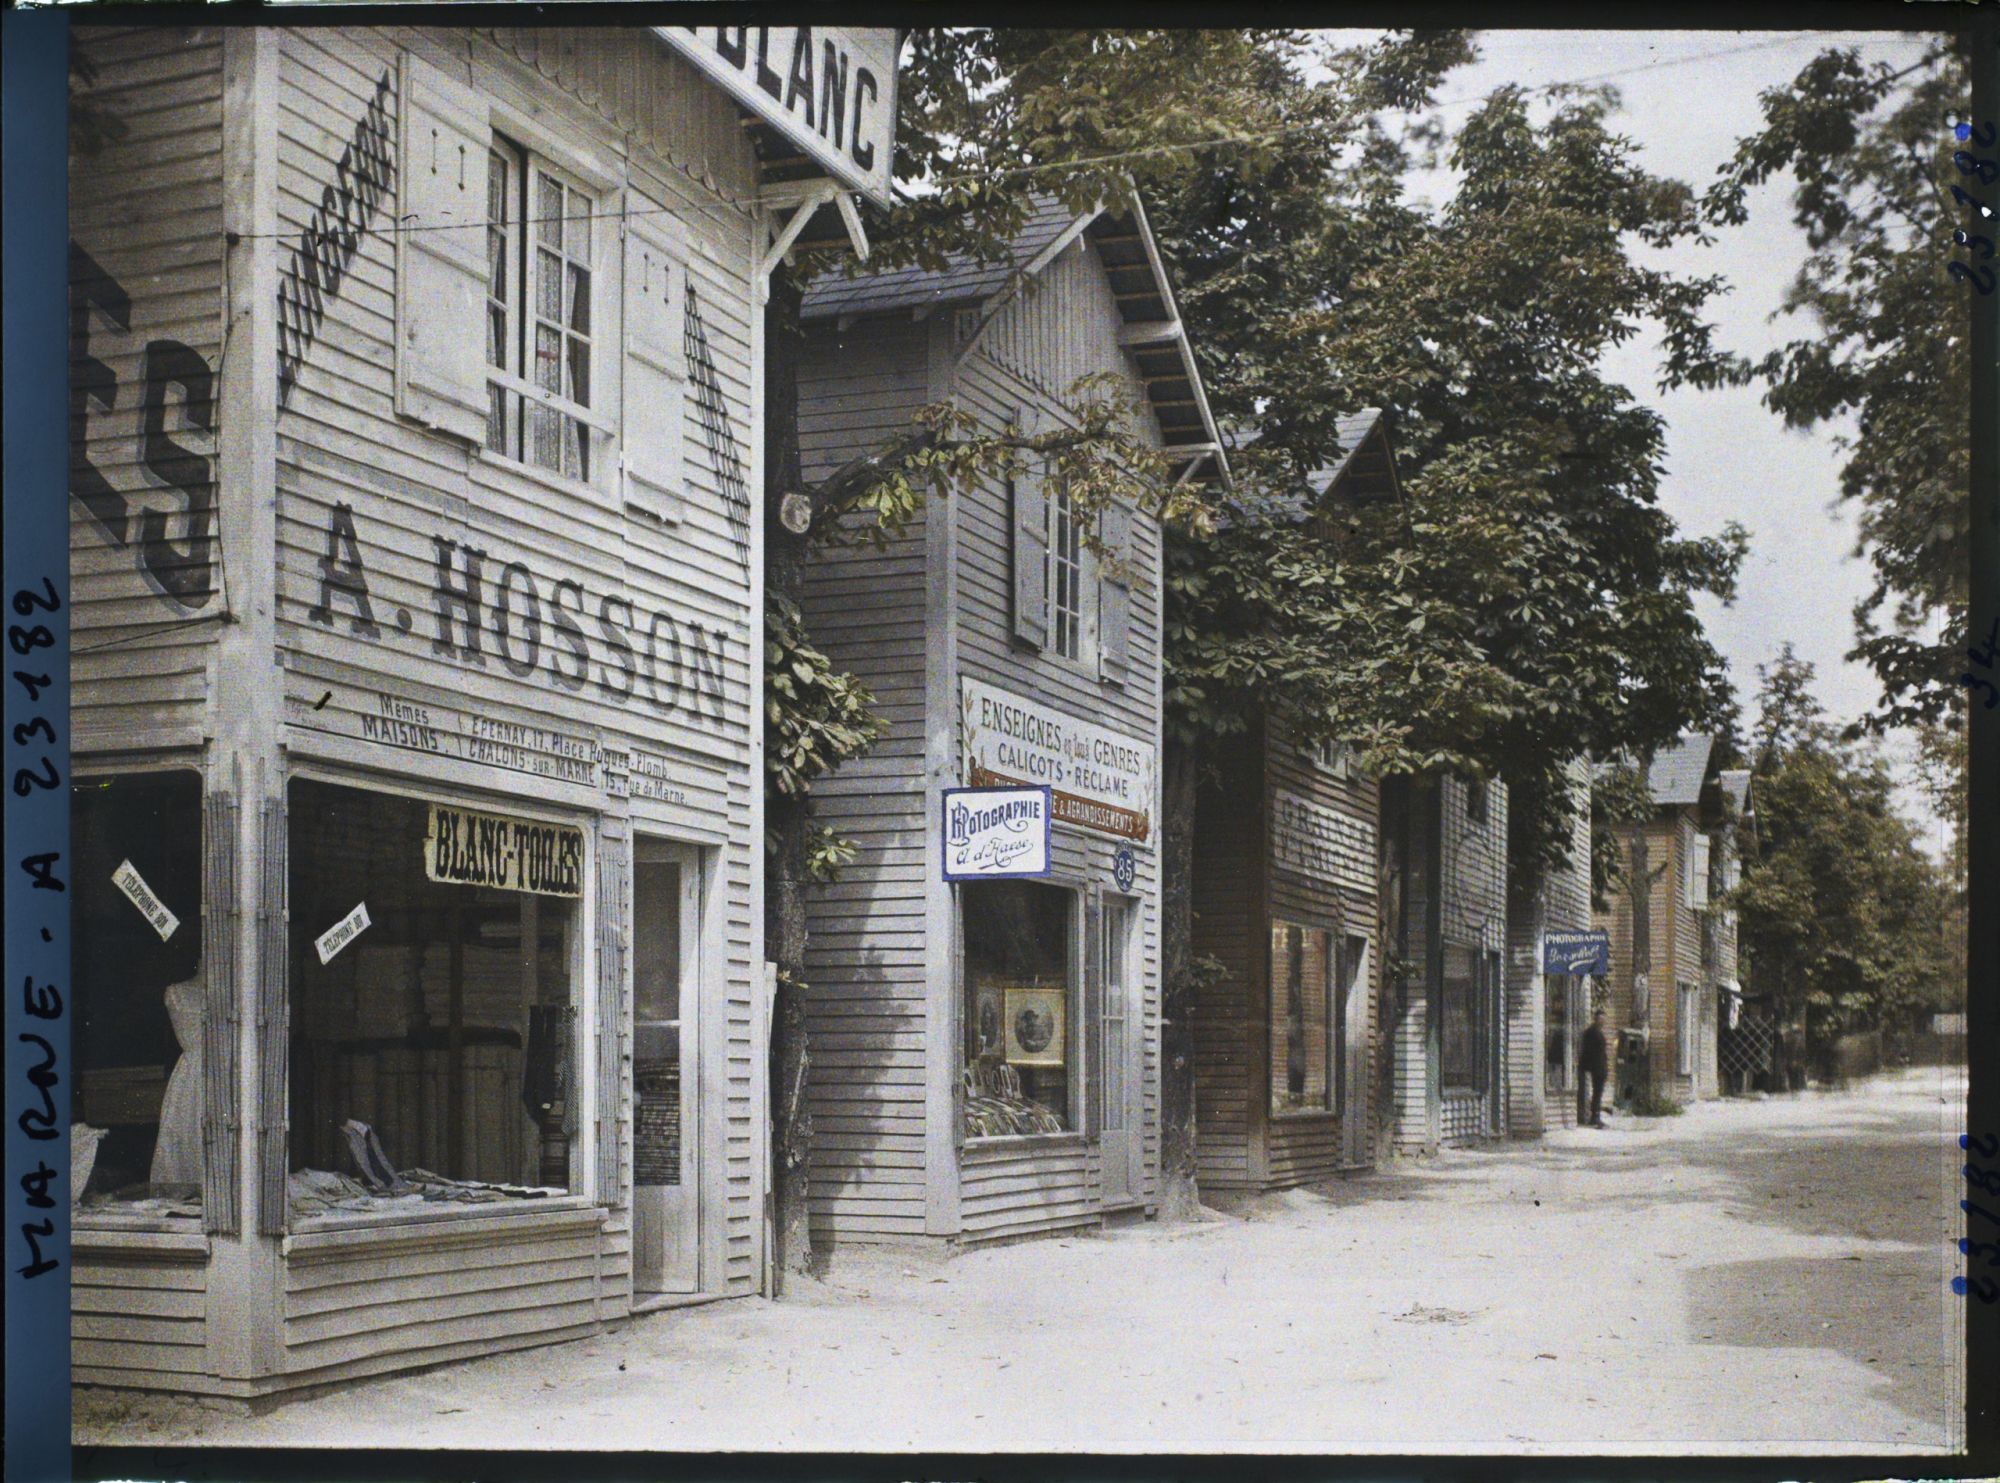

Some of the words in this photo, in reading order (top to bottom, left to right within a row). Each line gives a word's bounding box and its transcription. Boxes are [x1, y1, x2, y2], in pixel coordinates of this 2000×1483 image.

[308, 500, 413, 640] A.
[432, 533, 729, 730] HOSSON
[8, 576, 61, 796] 23182
[361, 715, 438, 750] MAISONS
[552, 732, 584, 759] Place
[981, 697, 1062, 753] ENSEIGNES
[1094, 738, 1141, 777] GENRES
[997, 742, 1063, 783] CALICOTS
[20, 851, 66, 892] A
[435, 809, 583, 894] BLANC-TOILES
[1117, 858, 1132, 882] 85
